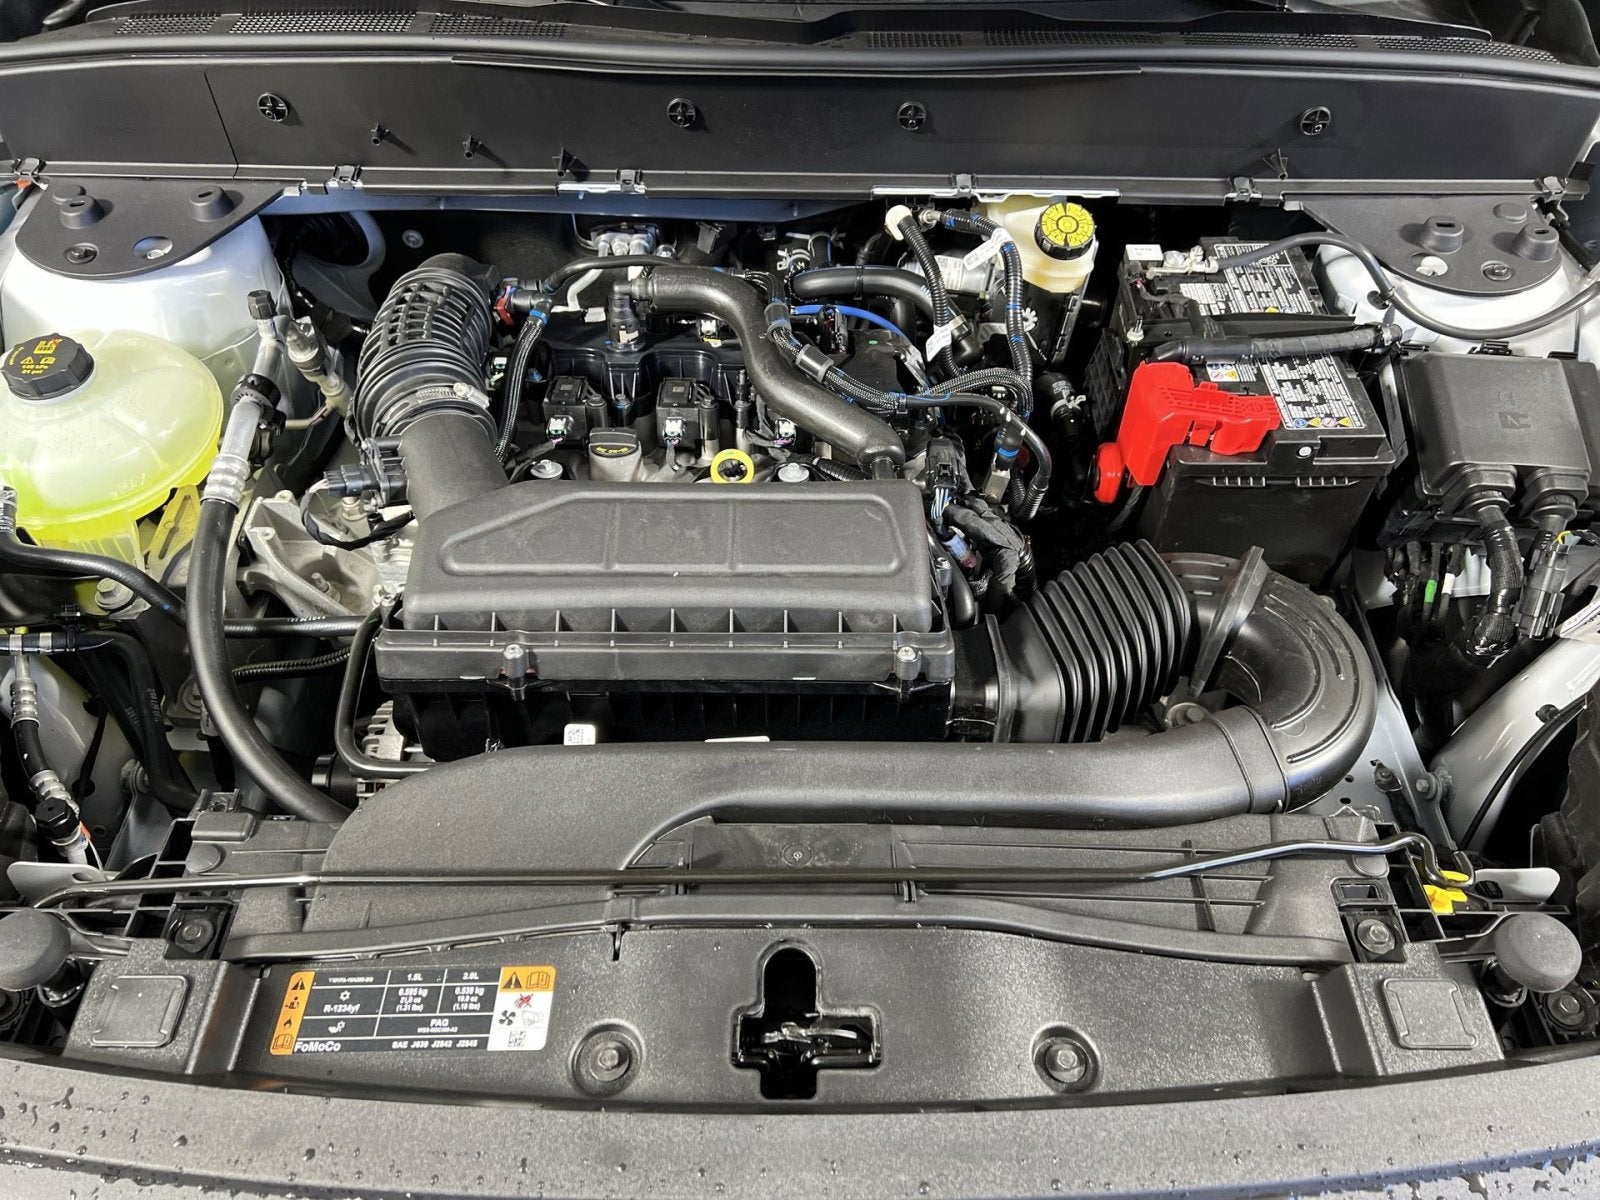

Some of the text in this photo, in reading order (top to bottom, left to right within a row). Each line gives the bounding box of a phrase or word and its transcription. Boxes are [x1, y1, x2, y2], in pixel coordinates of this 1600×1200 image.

[418, 987, 428, 997] kg
[474, 986, 484, 997] kg
[323, 1003, 361, 1014] R-1234yf
[412, 1003, 424, 1012] lbs)
[468, 1002, 481, 1011] lbs)
[430, 1018, 449, 1027] PAG
[294, 1041, 341, 1052] FoMoCo
[392, 1041, 408, 1049] SAE
